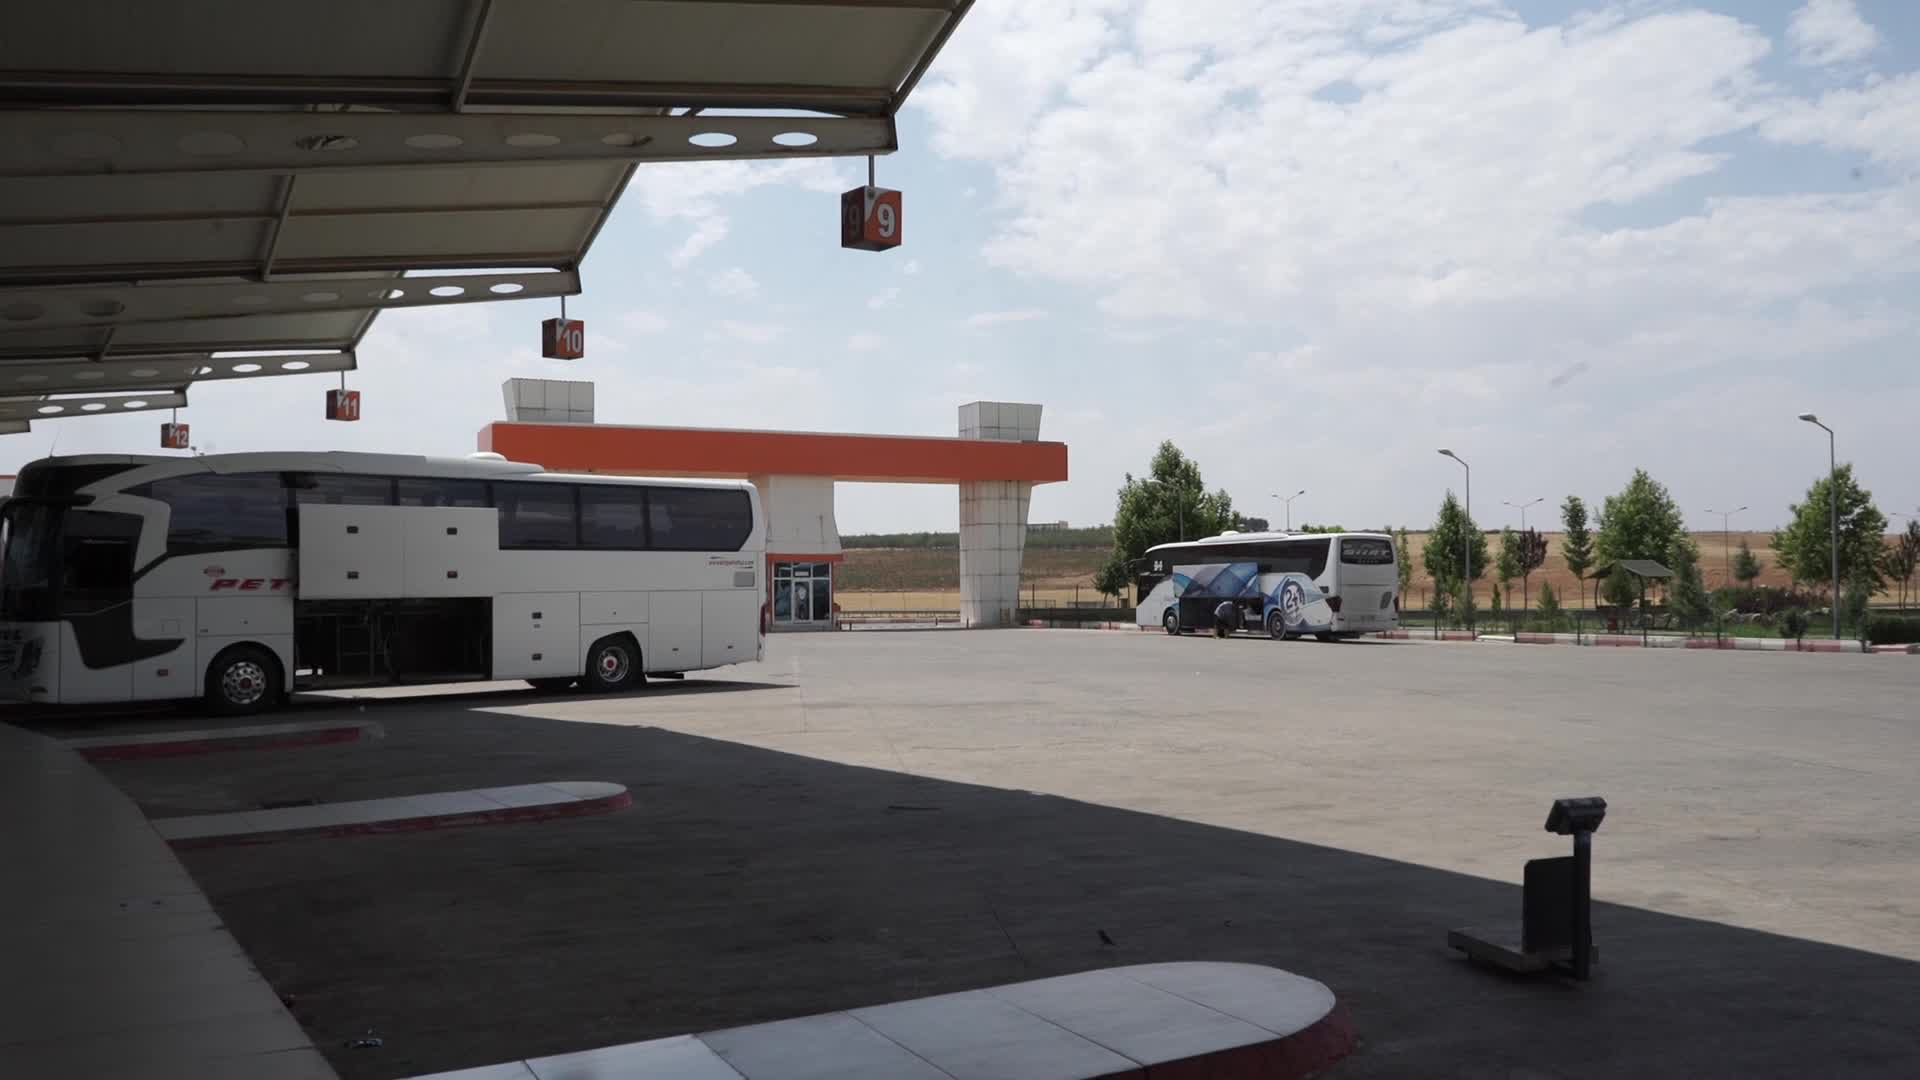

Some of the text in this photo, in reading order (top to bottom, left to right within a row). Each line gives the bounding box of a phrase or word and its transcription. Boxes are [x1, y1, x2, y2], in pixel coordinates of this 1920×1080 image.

[877, 203, 895, 238] 9
[563, 330, 582, 353] 10
[342, 397, 357, 417] 11
[176, 431, 188, 446] 12
